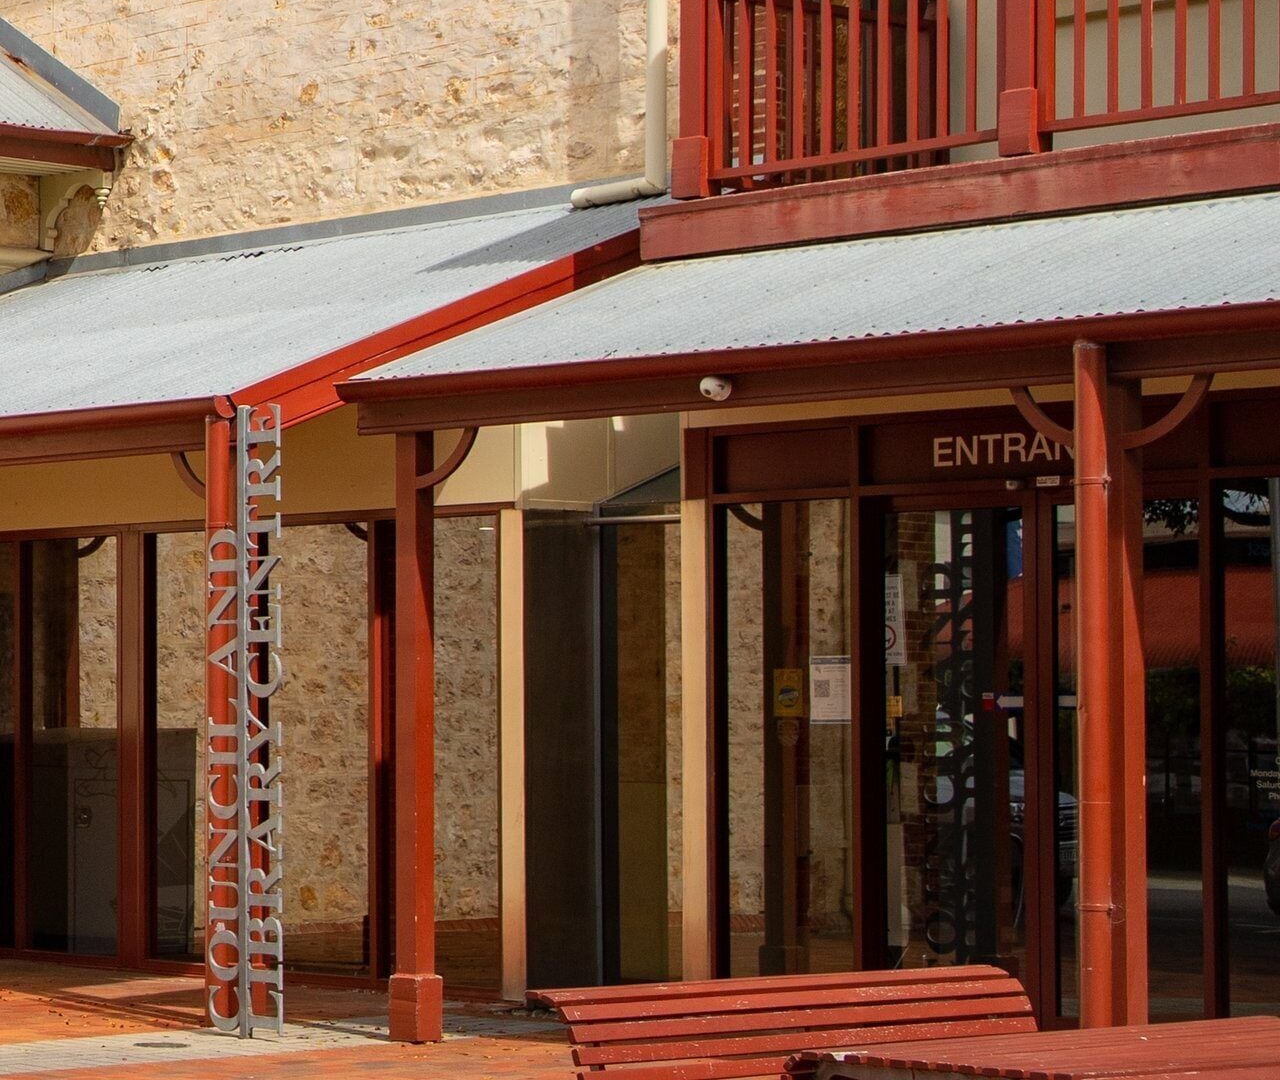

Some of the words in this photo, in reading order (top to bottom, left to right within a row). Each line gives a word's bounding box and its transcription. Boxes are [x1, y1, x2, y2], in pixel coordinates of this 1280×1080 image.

[208, 528, 241, 680] AND
[246, 402, 284, 698] CENTRE
[208, 699, 241, 1032] COUNCIL
[246, 702, 284, 1037] LIBRARY
